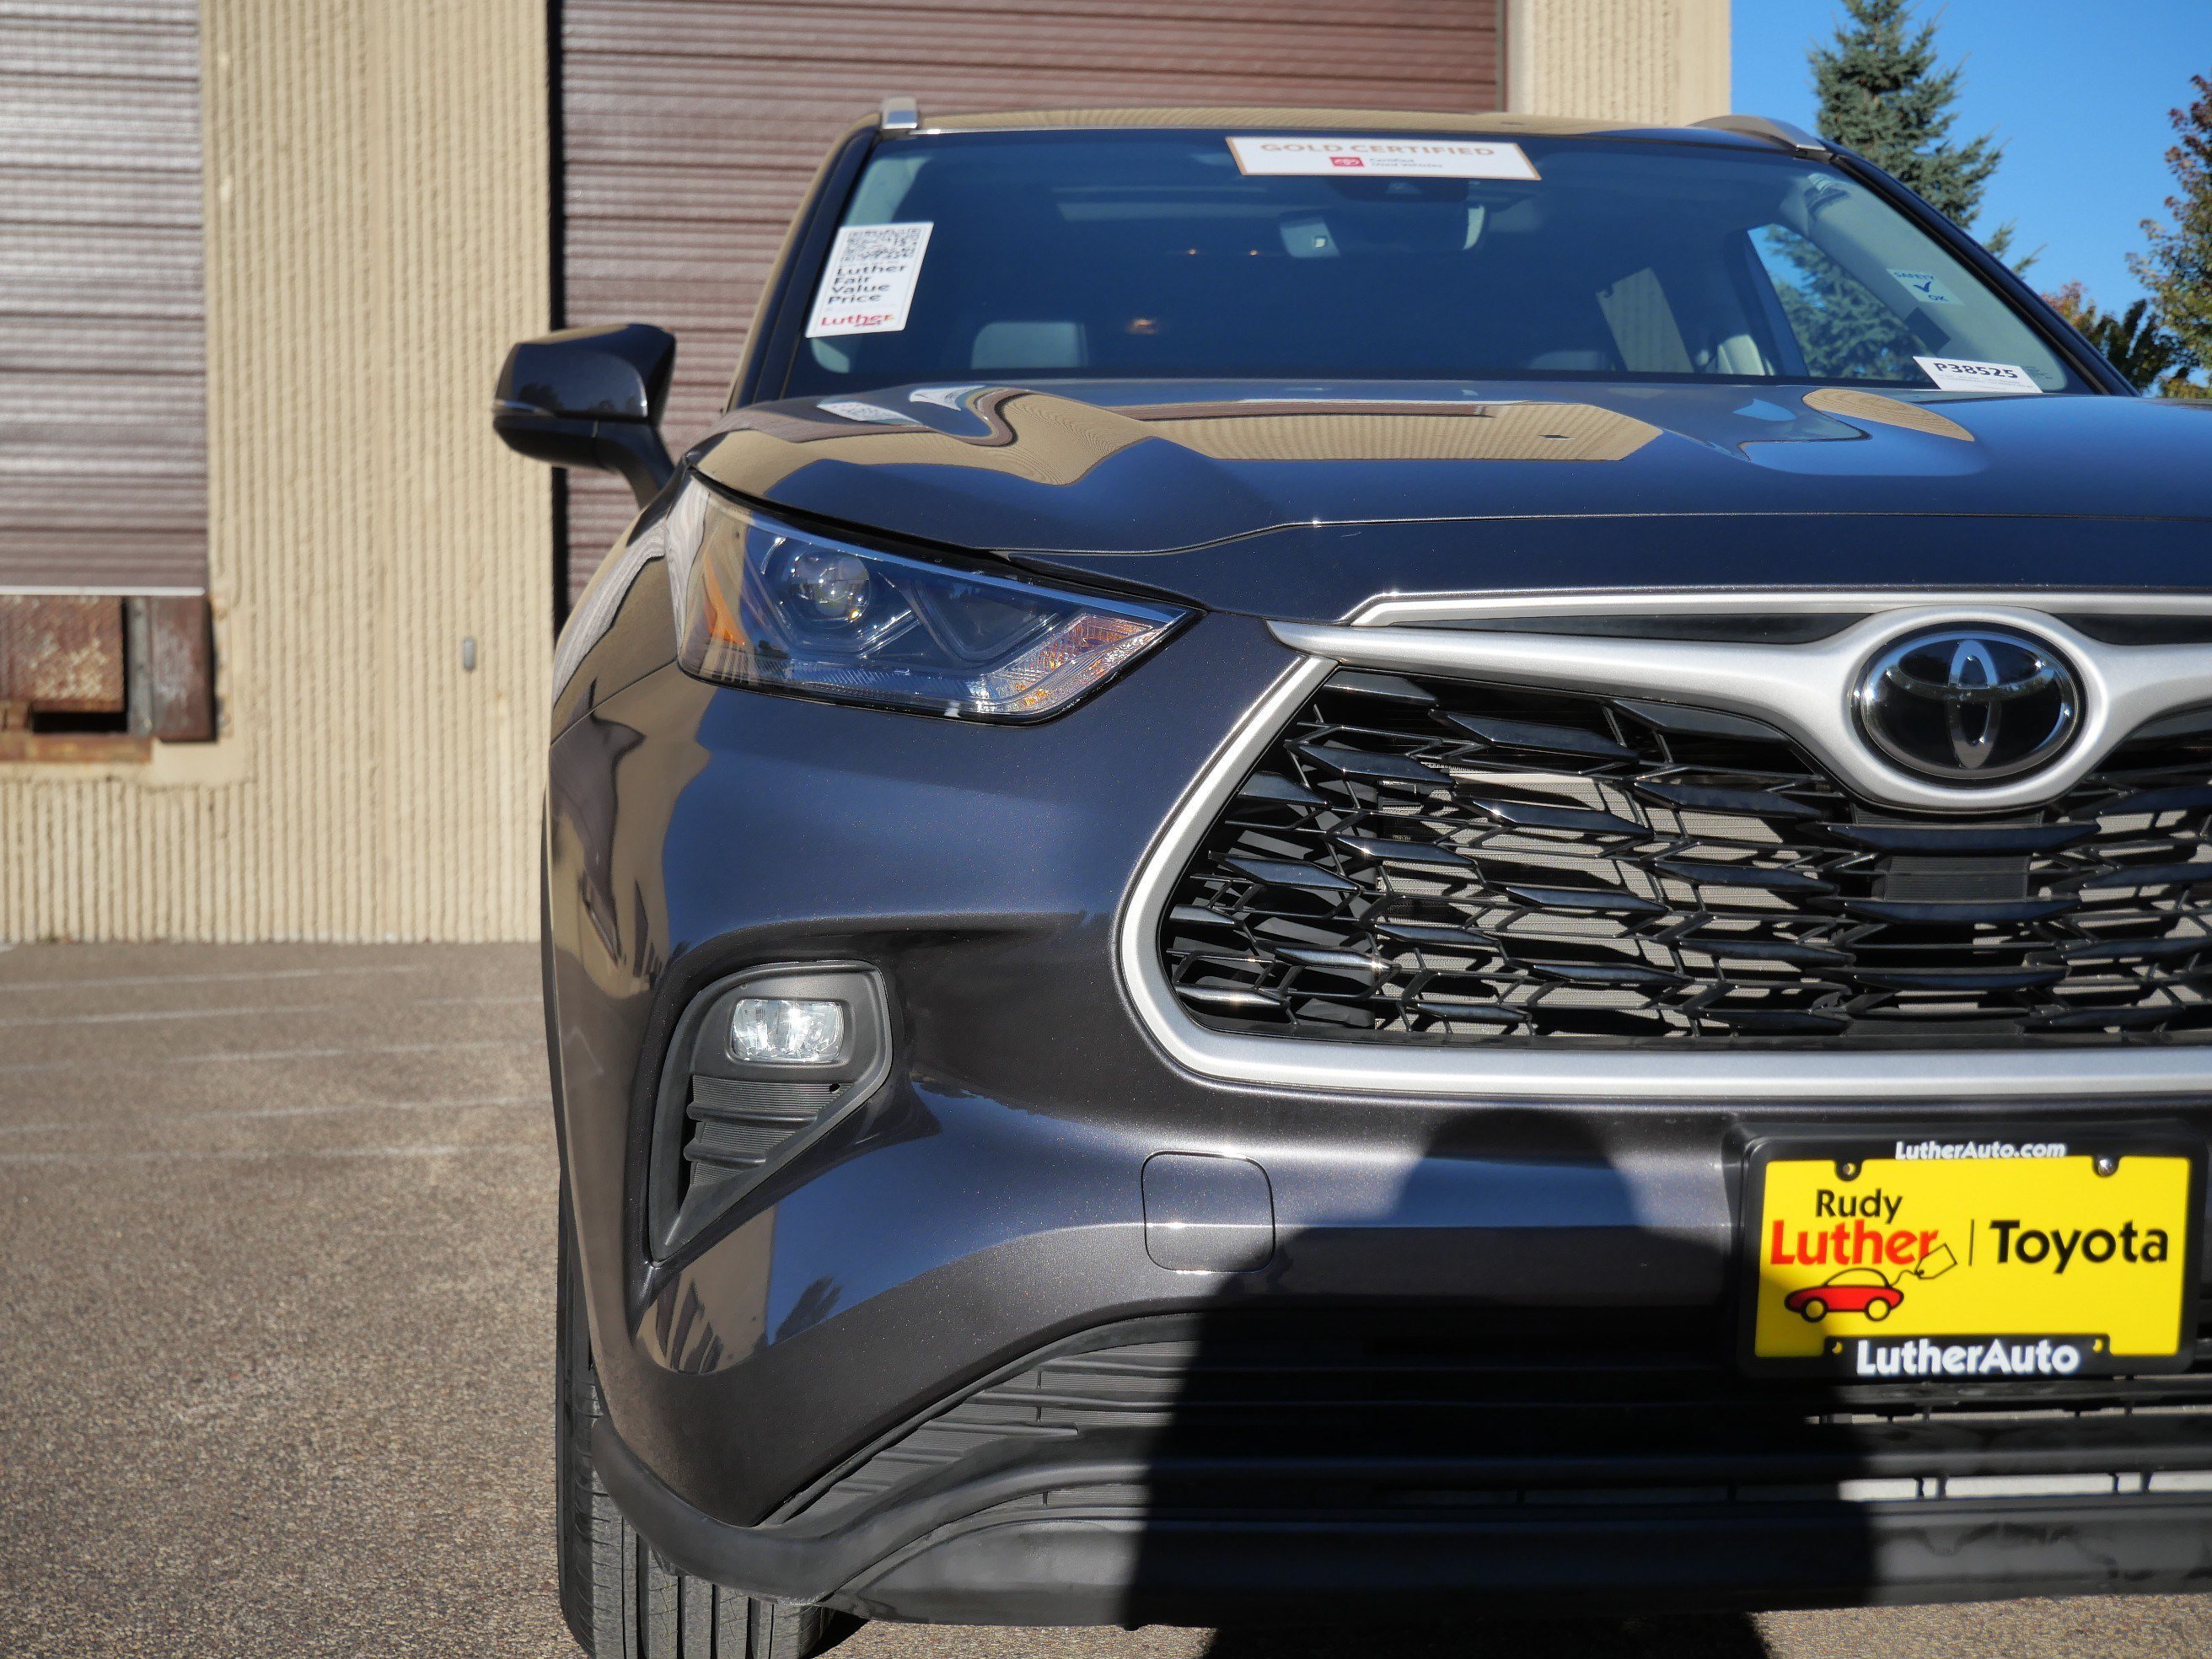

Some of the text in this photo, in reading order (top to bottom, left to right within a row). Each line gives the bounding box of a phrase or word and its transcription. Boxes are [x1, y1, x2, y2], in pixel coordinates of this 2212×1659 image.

[1260, 143, 1495, 156] GOLD CERTIFIED
[837, 265, 907, 276] Luther
[834, 276, 871, 285] Fair
[832, 284, 890, 294] Value
[828, 294, 881, 304] Price
[821, 314, 894, 326] Luther
[1933, 362, 2019, 379] P38525
[1895, 1141, 2067, 1160] LutherAuto.com
[1815, 1188, 1903, 1224] Rudy
[1770, 1219, 2169, 1274] Luther Toyota
[1856, 1338, 2080, 1377] LutherAuto
